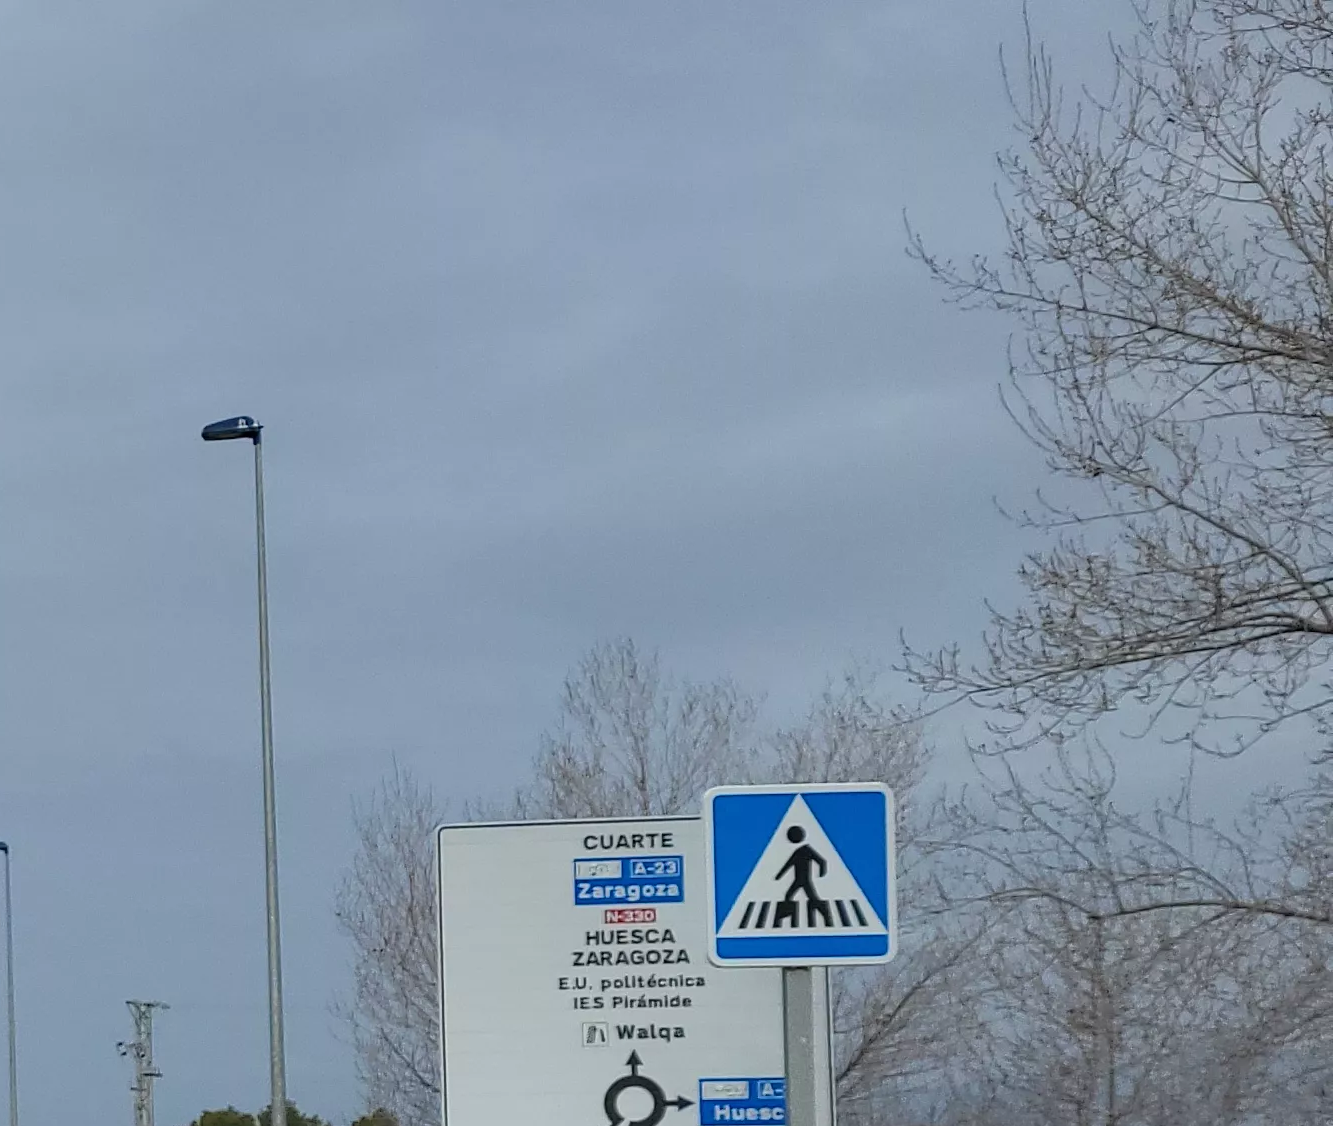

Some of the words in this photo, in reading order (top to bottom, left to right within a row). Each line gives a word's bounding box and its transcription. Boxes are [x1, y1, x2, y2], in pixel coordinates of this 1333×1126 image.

[583, 833, 674, 850] CUARTE
[634, 862, 677, 875] A-23
[577, 883, 679, 901] Zaragoza
[606, 910, 655, 922] N-330
[586, 929, 676, 946] HUESCA
[571, 949, 690, 967] ZARAGOZA
[558, 977, 593, 990] E.U.
[601, 974, 706, 991] politécnica
[573, 997, 604, 1009] IES
[612, 994, 692, 1009] Pirámide
[616, 1024, 686, 1042] Walqa
[762, 1083, 786, 1096] A-
[714, 1104, 785, 1121] Huesc
